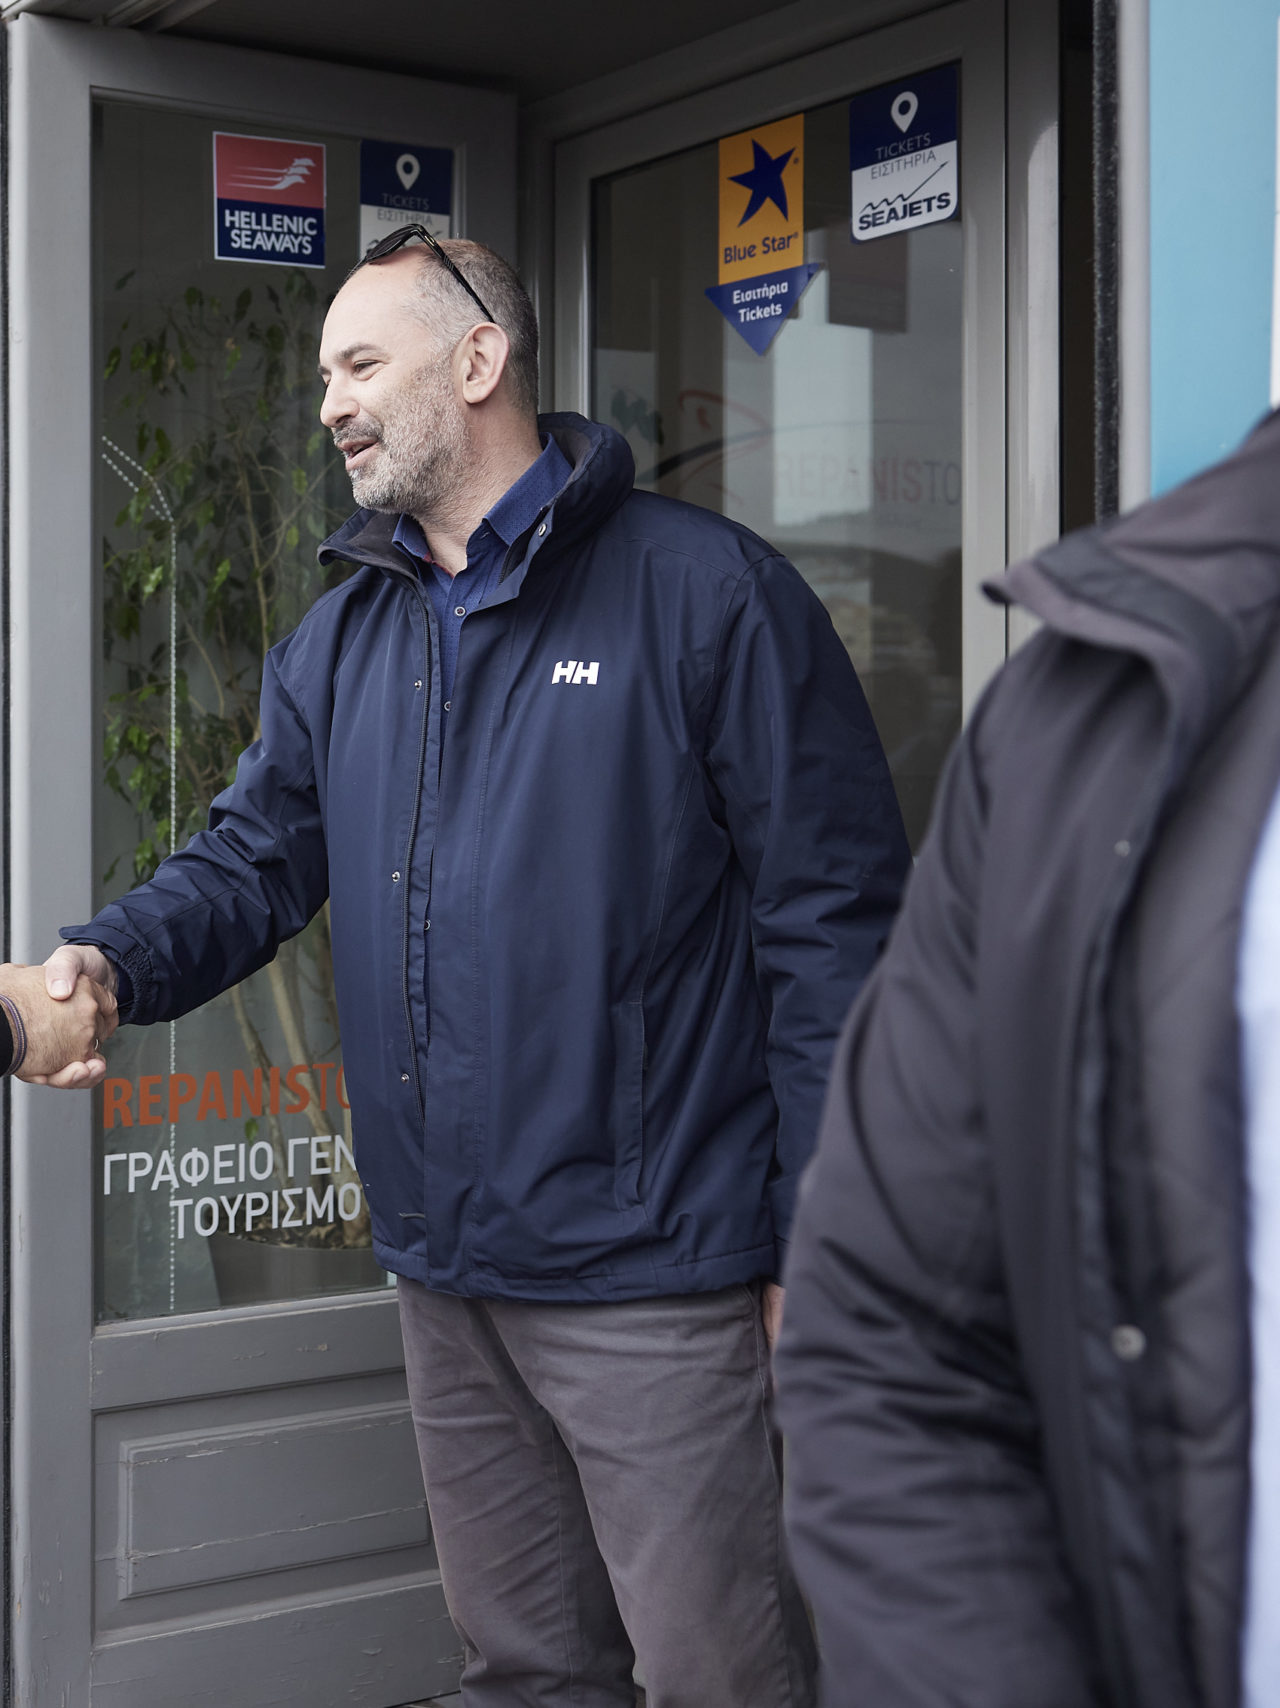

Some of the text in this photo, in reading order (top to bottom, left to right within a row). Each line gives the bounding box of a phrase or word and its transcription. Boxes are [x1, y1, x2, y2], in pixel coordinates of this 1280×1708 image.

[875, 133, 931, 160] TICKETS
[870, 150, 937, 180] ΕΙΣΙΤΗΡΙΑ
[382, 193, 430, 211] TICKETS
[858, 191, 951, 231] SEAJETS
[224, 209, 318, 235] HELLENIC
[377, 208, 433, 226] ΕΙΣΙΤΗΡΙΑ
[230, 229, 312, 255] SEAWAYS
[723, 244, 757, 265] Blue
[732, 281, 789, 305] Εισιτήρια
[738, 302, 783, 323] Tickets
[551, 660, 600, 685] HH
[104, 1134, 357, 1195] ΓΡΑΦΕΙΟ ΓΕΝ
[170, 1182, 361, 1239] ΤΟΥΡΙΣΜΟ
